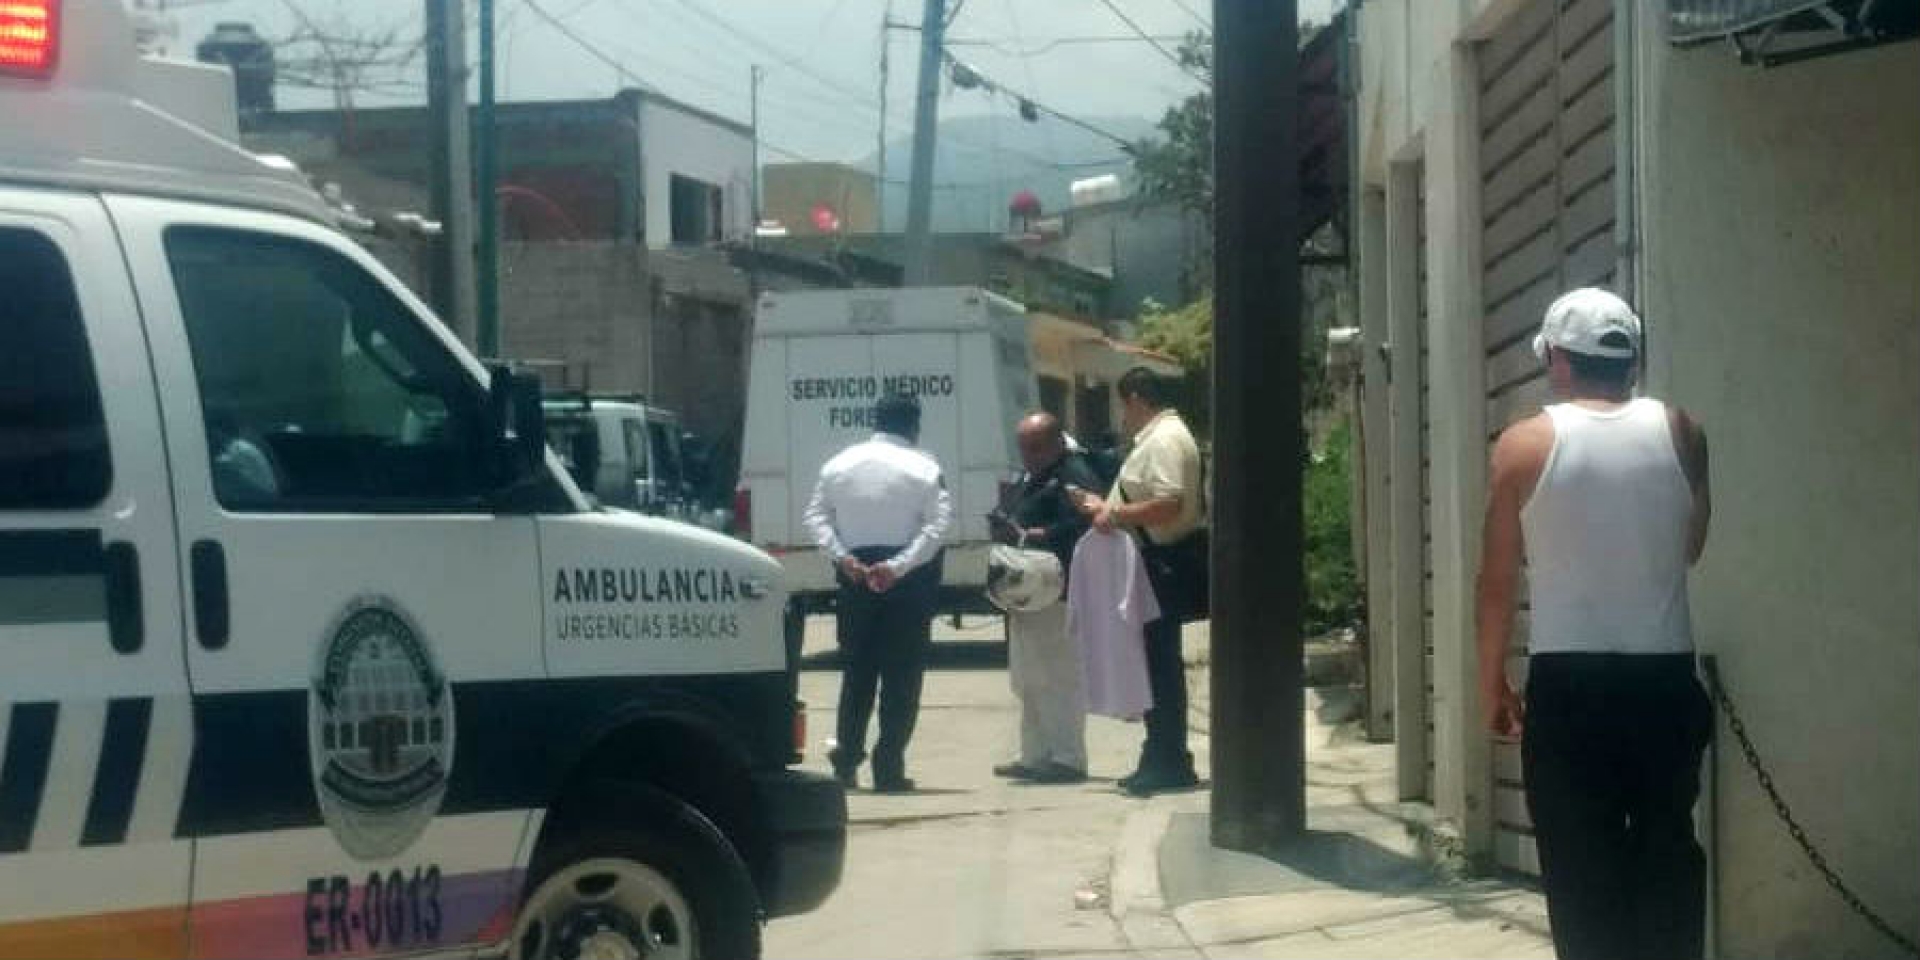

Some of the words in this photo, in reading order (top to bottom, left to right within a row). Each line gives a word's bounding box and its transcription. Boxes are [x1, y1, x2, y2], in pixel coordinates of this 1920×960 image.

[792, 375, 877, 401] SERVICIO
[829, 406, 880, 429] FORE
[554, 568, 736, 602] AMBULANCIA
[556, 613, 662, 640] URGENCIAS
[305, 864, 442, 956] ER-0013
